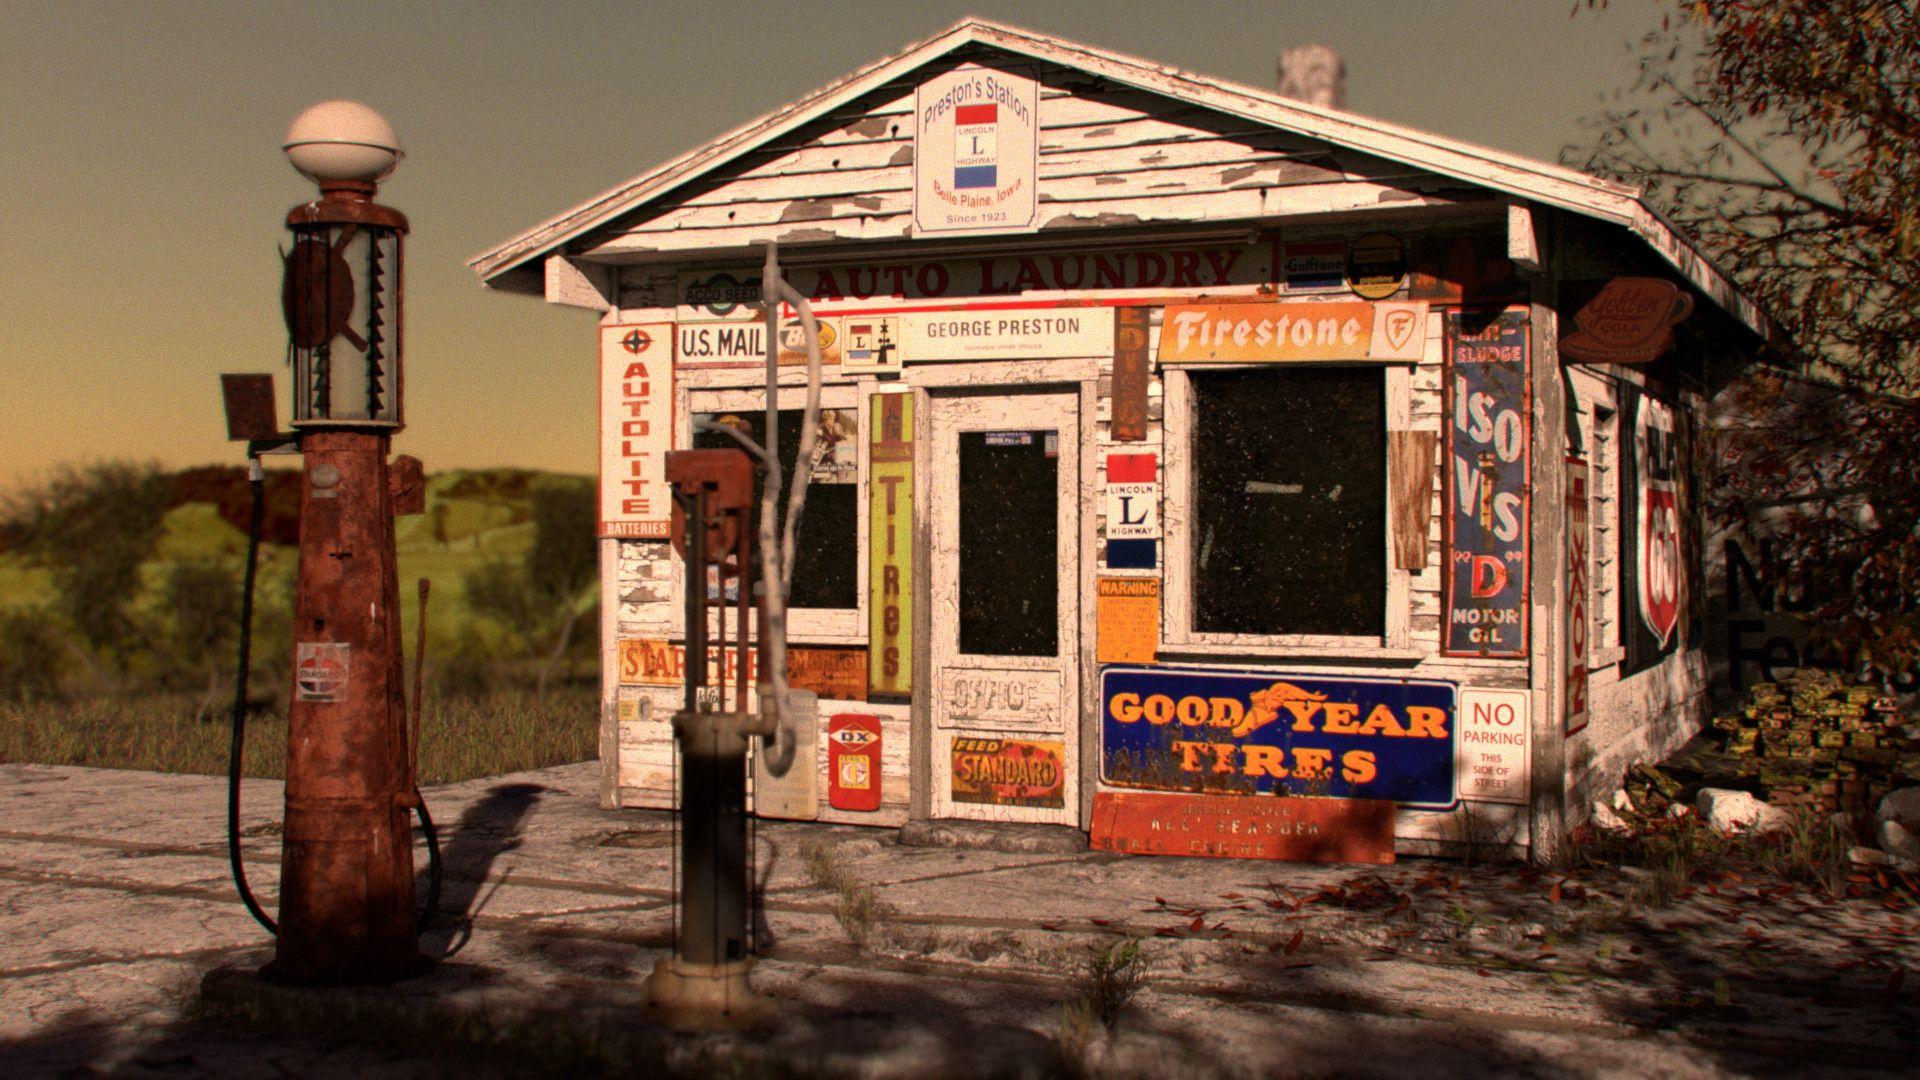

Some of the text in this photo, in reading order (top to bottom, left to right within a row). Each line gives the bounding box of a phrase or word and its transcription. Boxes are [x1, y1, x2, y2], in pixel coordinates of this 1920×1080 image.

[925, 76, 1029, 133] Preston's Station
[958, 126, 995, 135] LINCOLN
[971, 136, 985, 155] L
[957, 157, 995, 166] HIGHWAY
[997, 177, 1022, 201] Iowa
[946, 212, 1007, 224] Since 1923
[810, 250, 1243, 303] AUTO LAUNDRY
[685, 287, 758, 300] ACCO SEED
[928, 318, 1080, 338] GEORGE PRESTON
[1173, 311, 1361, 353] Firestone
[682, 329, 713, 356] U.S.
[717, 328, 766, 356] MAIL
[1456, 346, 1522, 363] SLUDGE
[1454, 374, 1523, 464] ISO
[622, 362, 650, 514] AUTOLITE
[1110, 486, 1153, 494] LINCOLN
[1118, 496, 1149, 525] L
[607, 522, 667, 536] BATTERIES
[1111, 527, 1153, 536] HIGHWAY
[1101, 581, 1157, 596] WARNING
[1452, 608, 1520, 625] MOTOR
[1468, 628, 1503, 644] OIL
[1473, 702, 1515, 726] NO
[840, 731, 868, 742] DX
[1463, 731, 1524, 746] PARKING
[956, 740, 999, 752] FEED
[1172, 741, 1377, 785] TIRES
[1481, 753, 1502, 762] THIS
[961, 754, 1056, 787] STANDARD
[1473, 765, 1509, 775] SIDE OF
[1473, 778, 1508, 788] STREET
